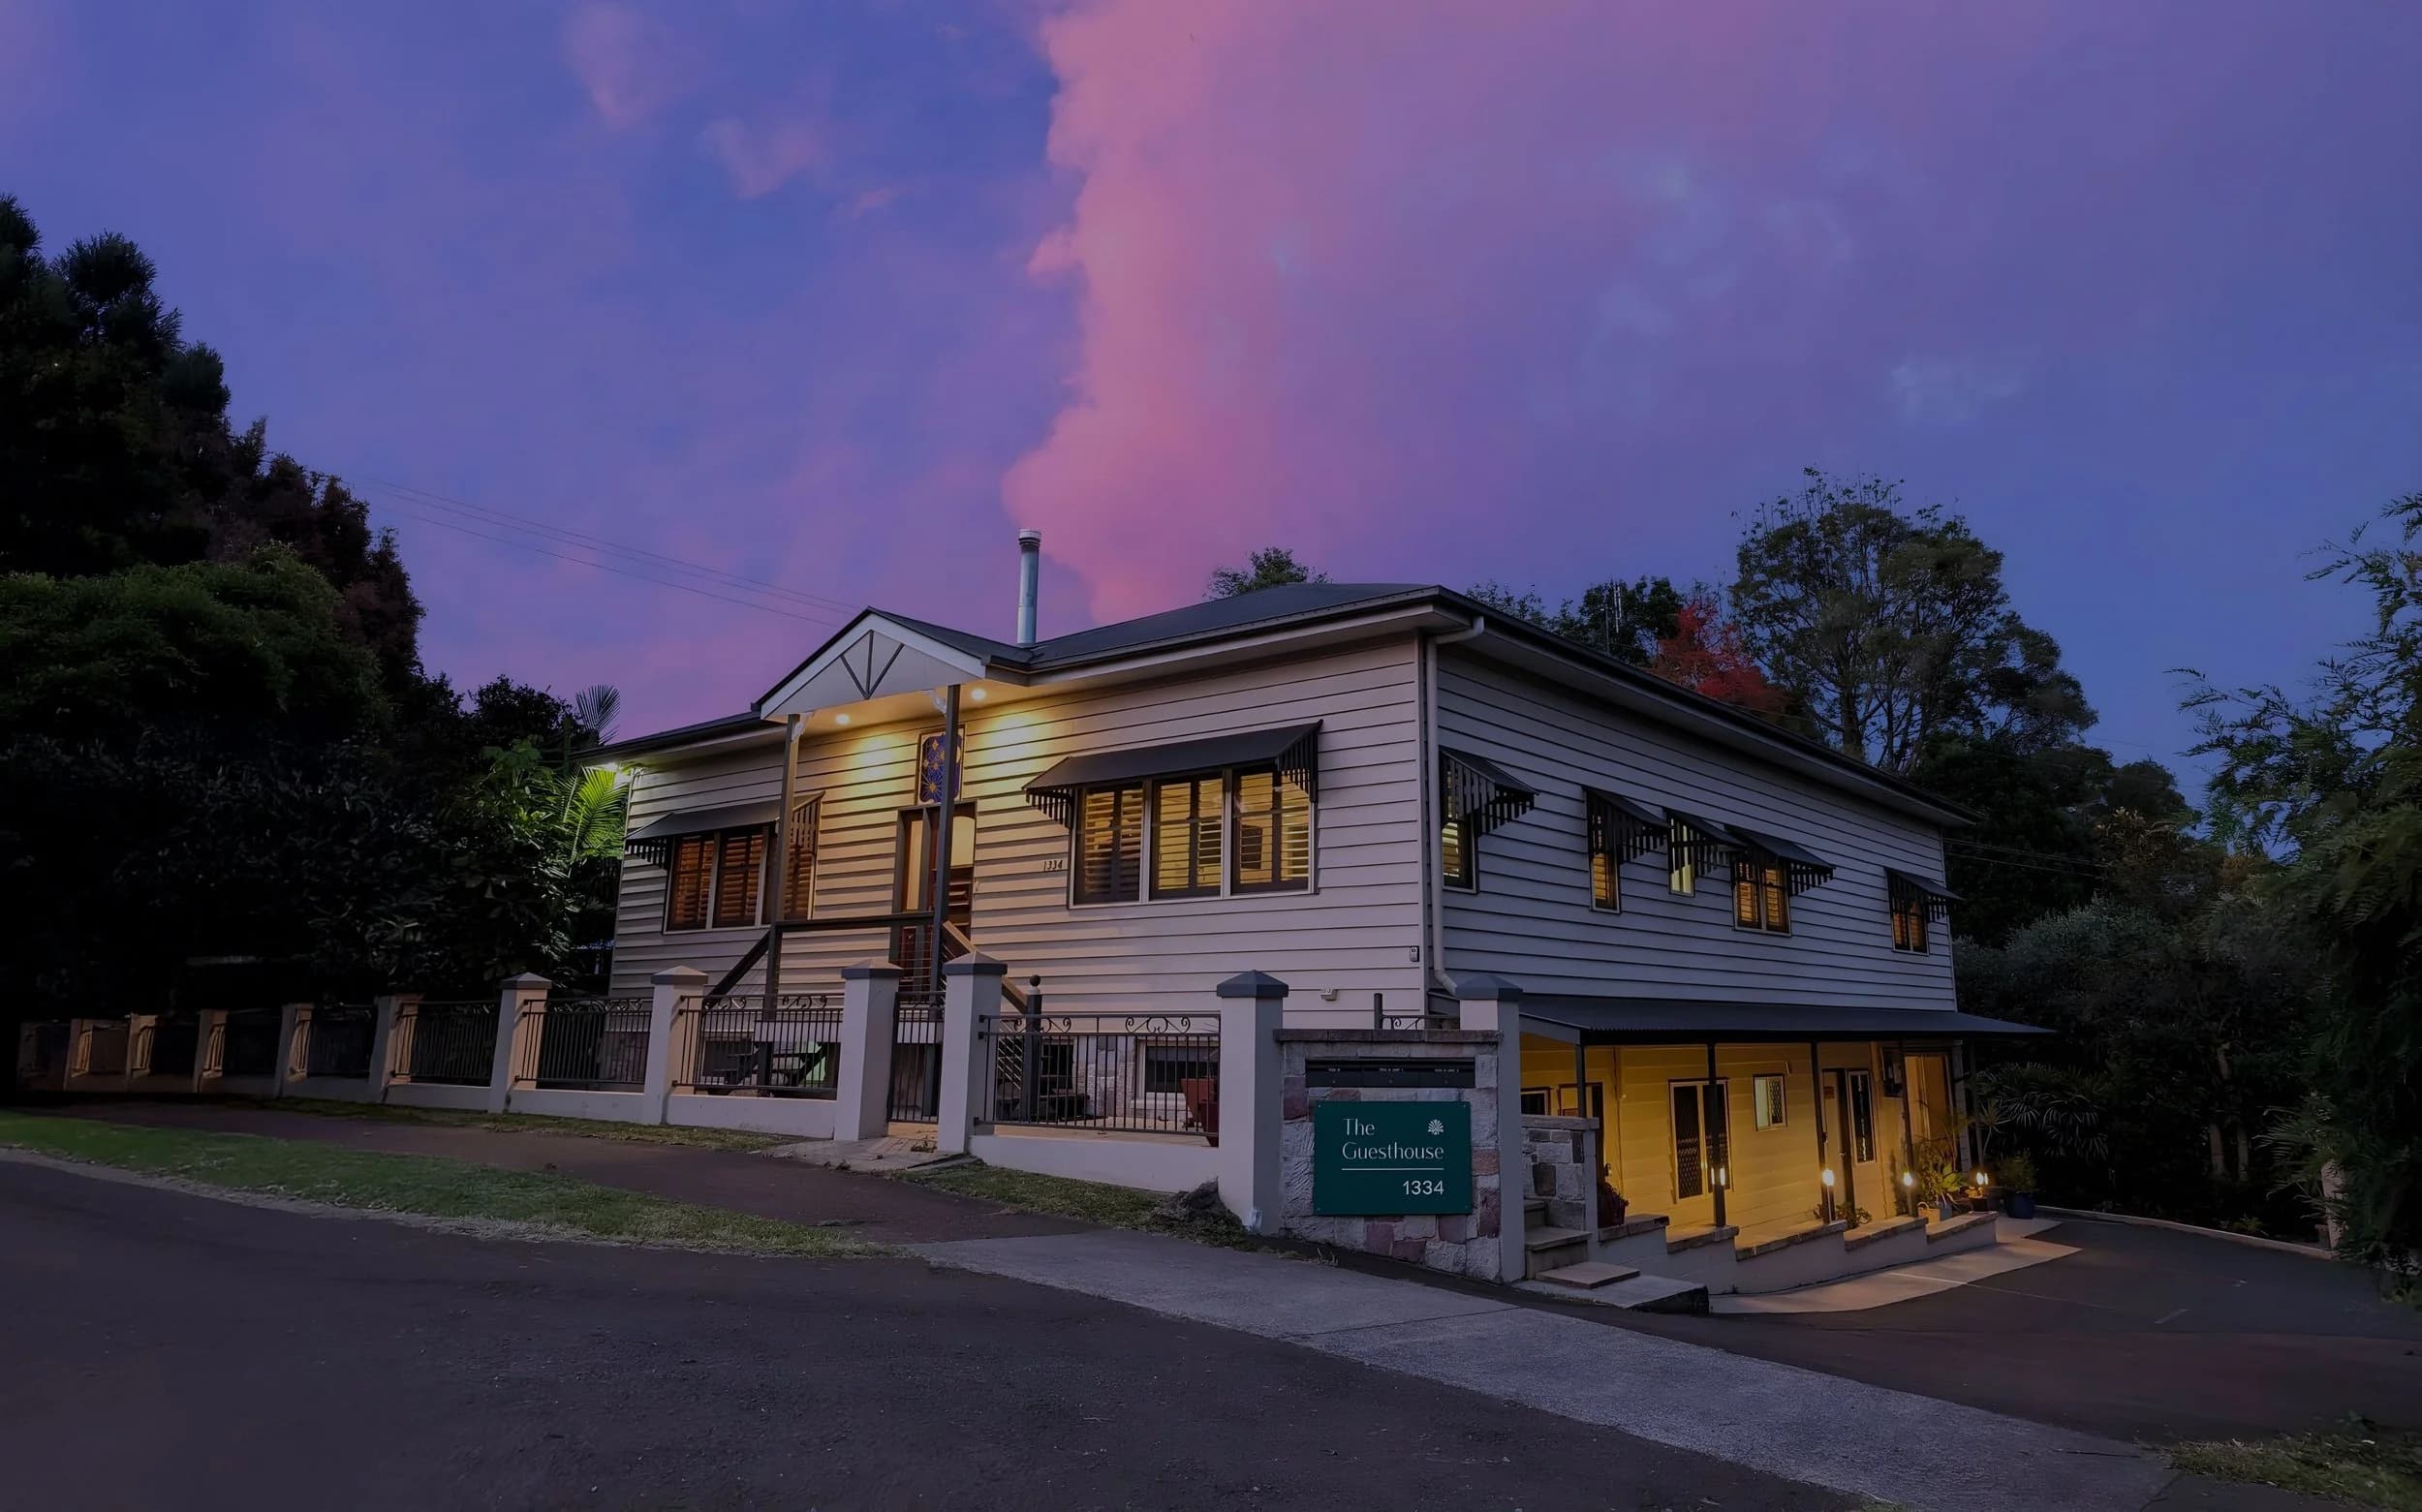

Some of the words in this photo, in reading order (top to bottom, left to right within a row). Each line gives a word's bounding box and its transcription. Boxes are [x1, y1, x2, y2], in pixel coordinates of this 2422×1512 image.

[1043, 859, 1063, 872] 1334
[1344, 1118, 1376, 1136] The
[1342, 1141, 1444, 1160] Guesthouse
[1403, 1180, 1444, 1195] 1334
